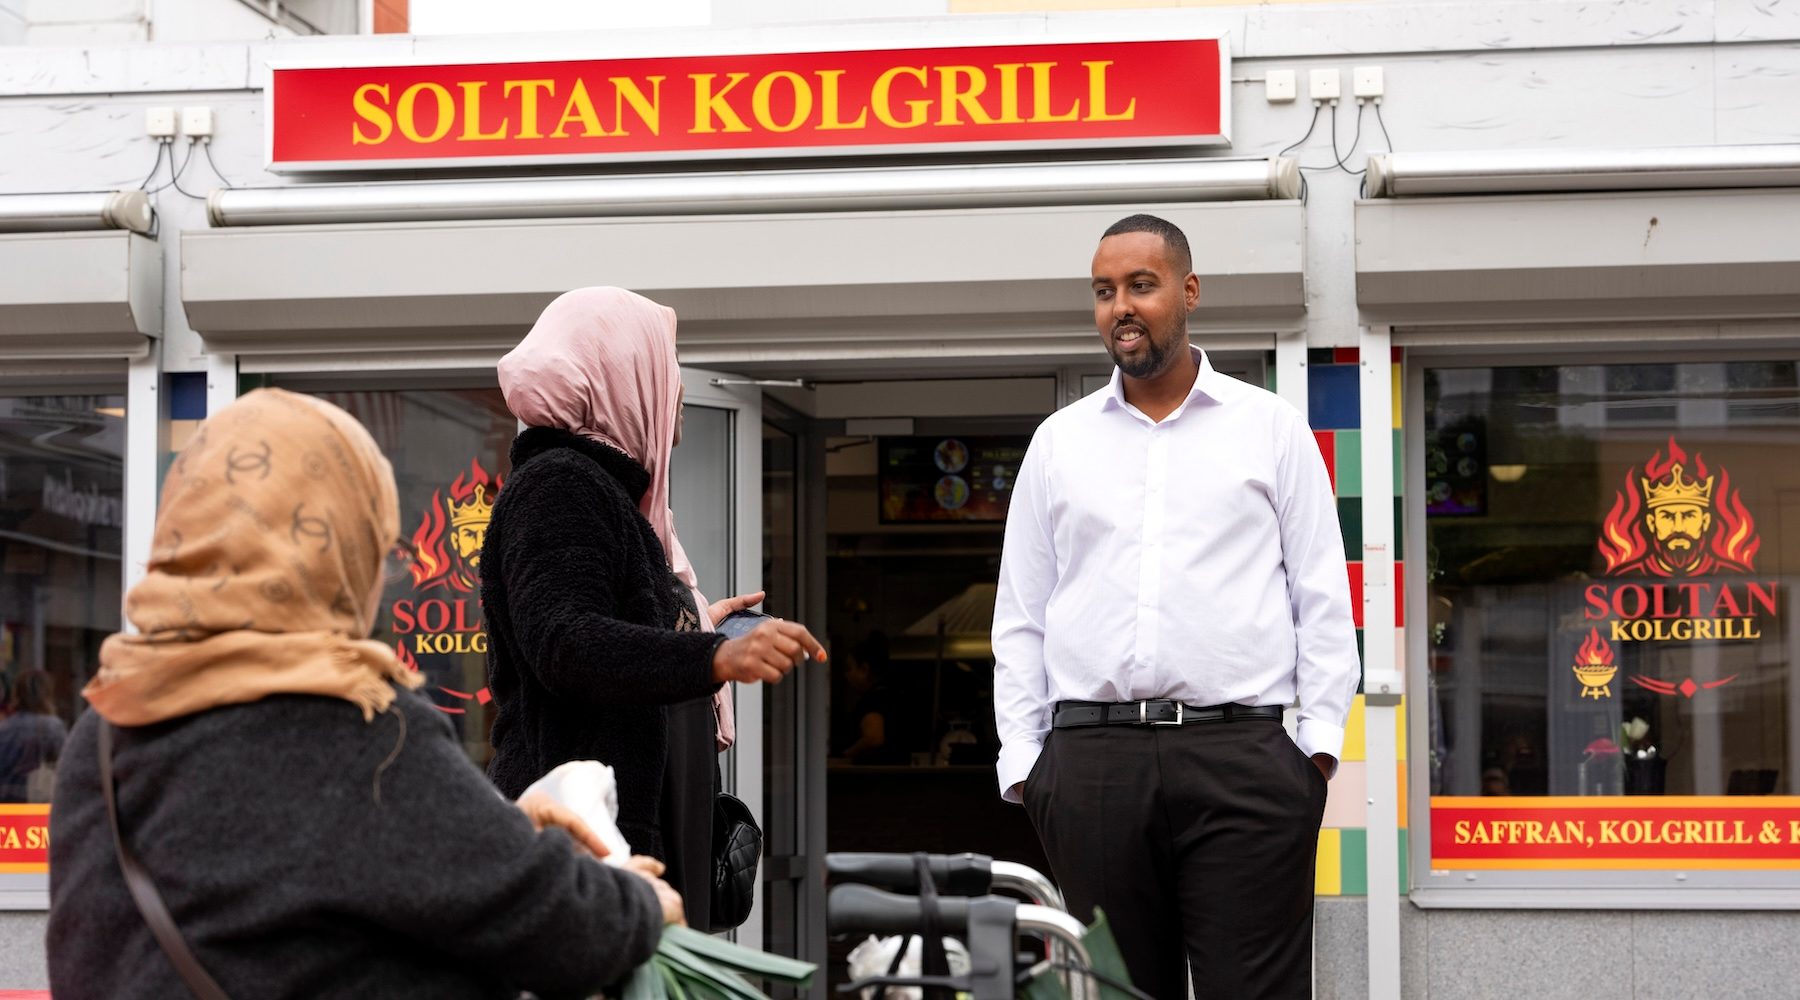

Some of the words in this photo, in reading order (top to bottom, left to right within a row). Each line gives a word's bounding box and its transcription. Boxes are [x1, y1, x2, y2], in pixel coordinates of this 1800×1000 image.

[352, 75, 666, 146] SOLTAN
[688, 60, 1137, 134] KOLGRILL
[392, 598, 483, 635] SOL
[1585, 582, 1777, 619] SOLTAN
[1610, 618, 1761, 641] KOLGRILL
[1455, 820, 1593, 848] SAFFRAN,
[1599, 820, 1753, 845] KOLGRILL
[1758, 820, 1782, 844] &
